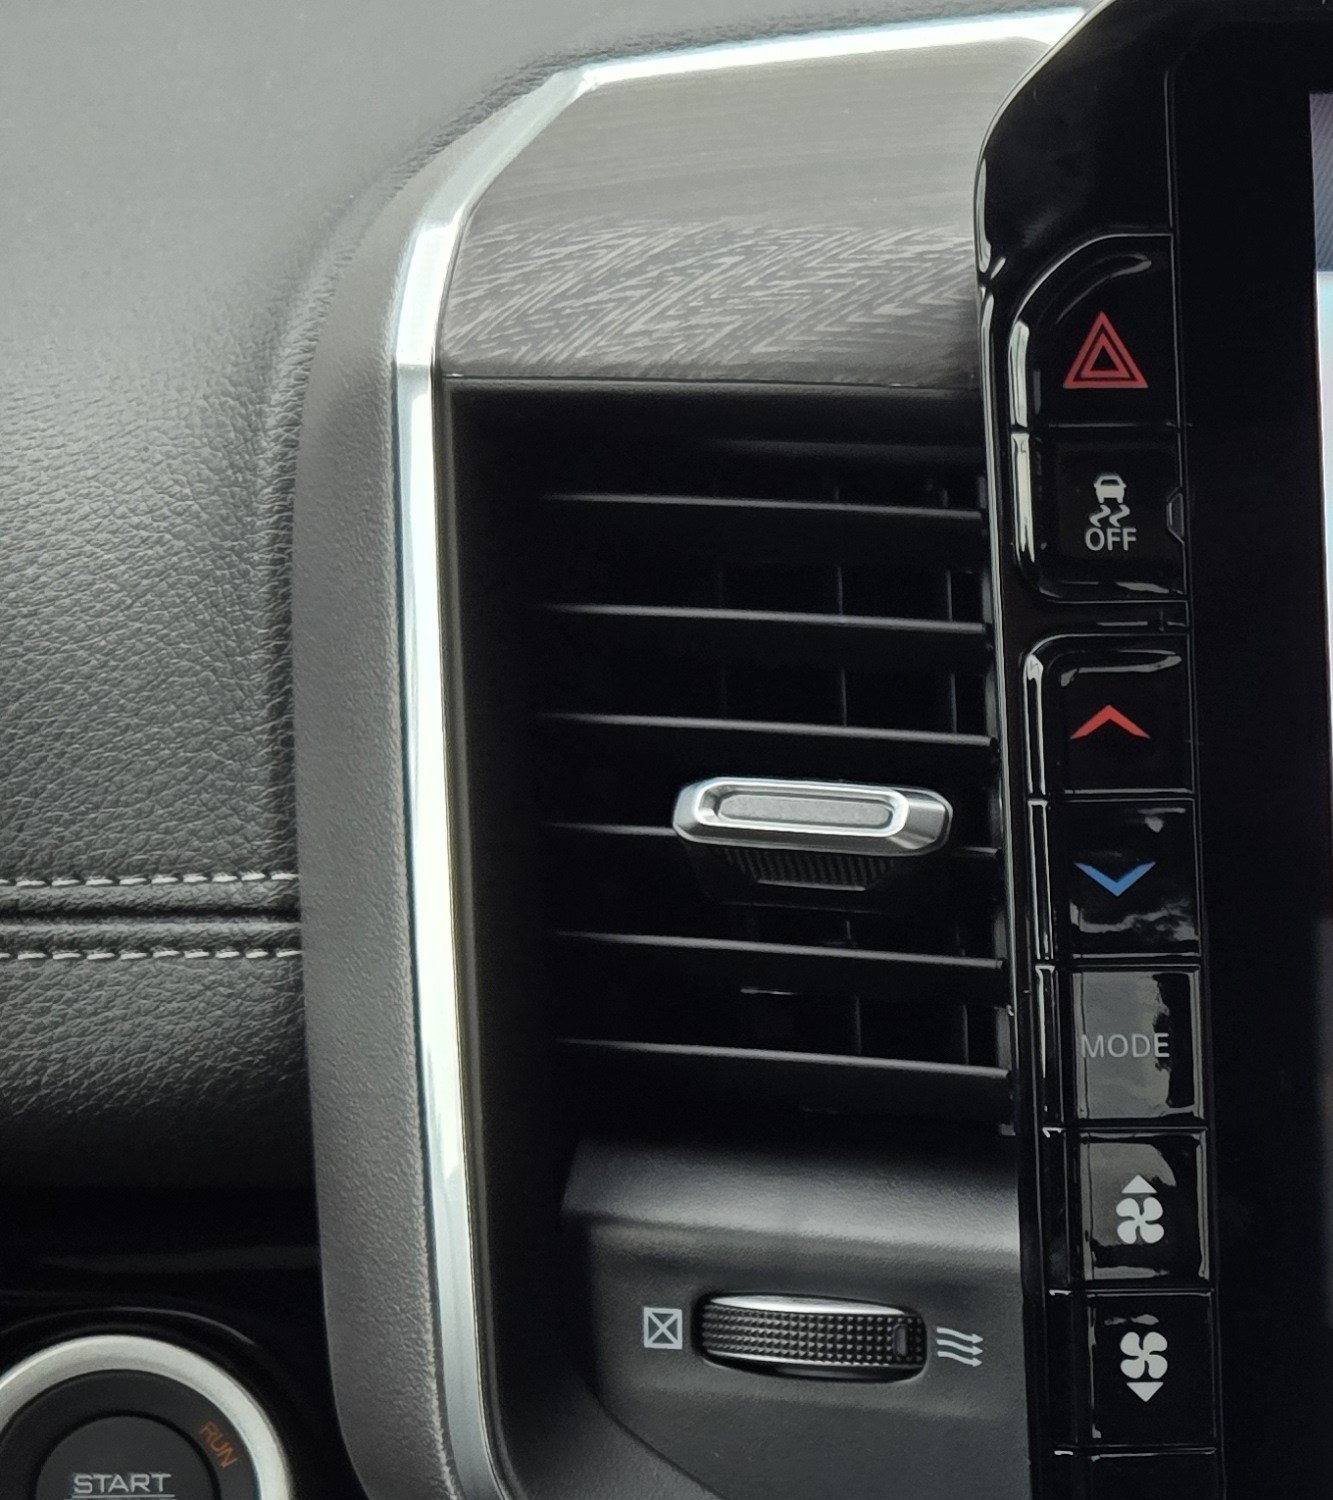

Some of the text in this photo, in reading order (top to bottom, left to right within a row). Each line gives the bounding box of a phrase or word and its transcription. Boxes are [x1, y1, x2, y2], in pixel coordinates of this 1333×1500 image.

[1084, 527, 1137, 551] OFF
[1080, 1032, 1170, 1058] MODE
[200, 1420, 238, 1468] RUN
[73, 1473, 172, 1494] START
